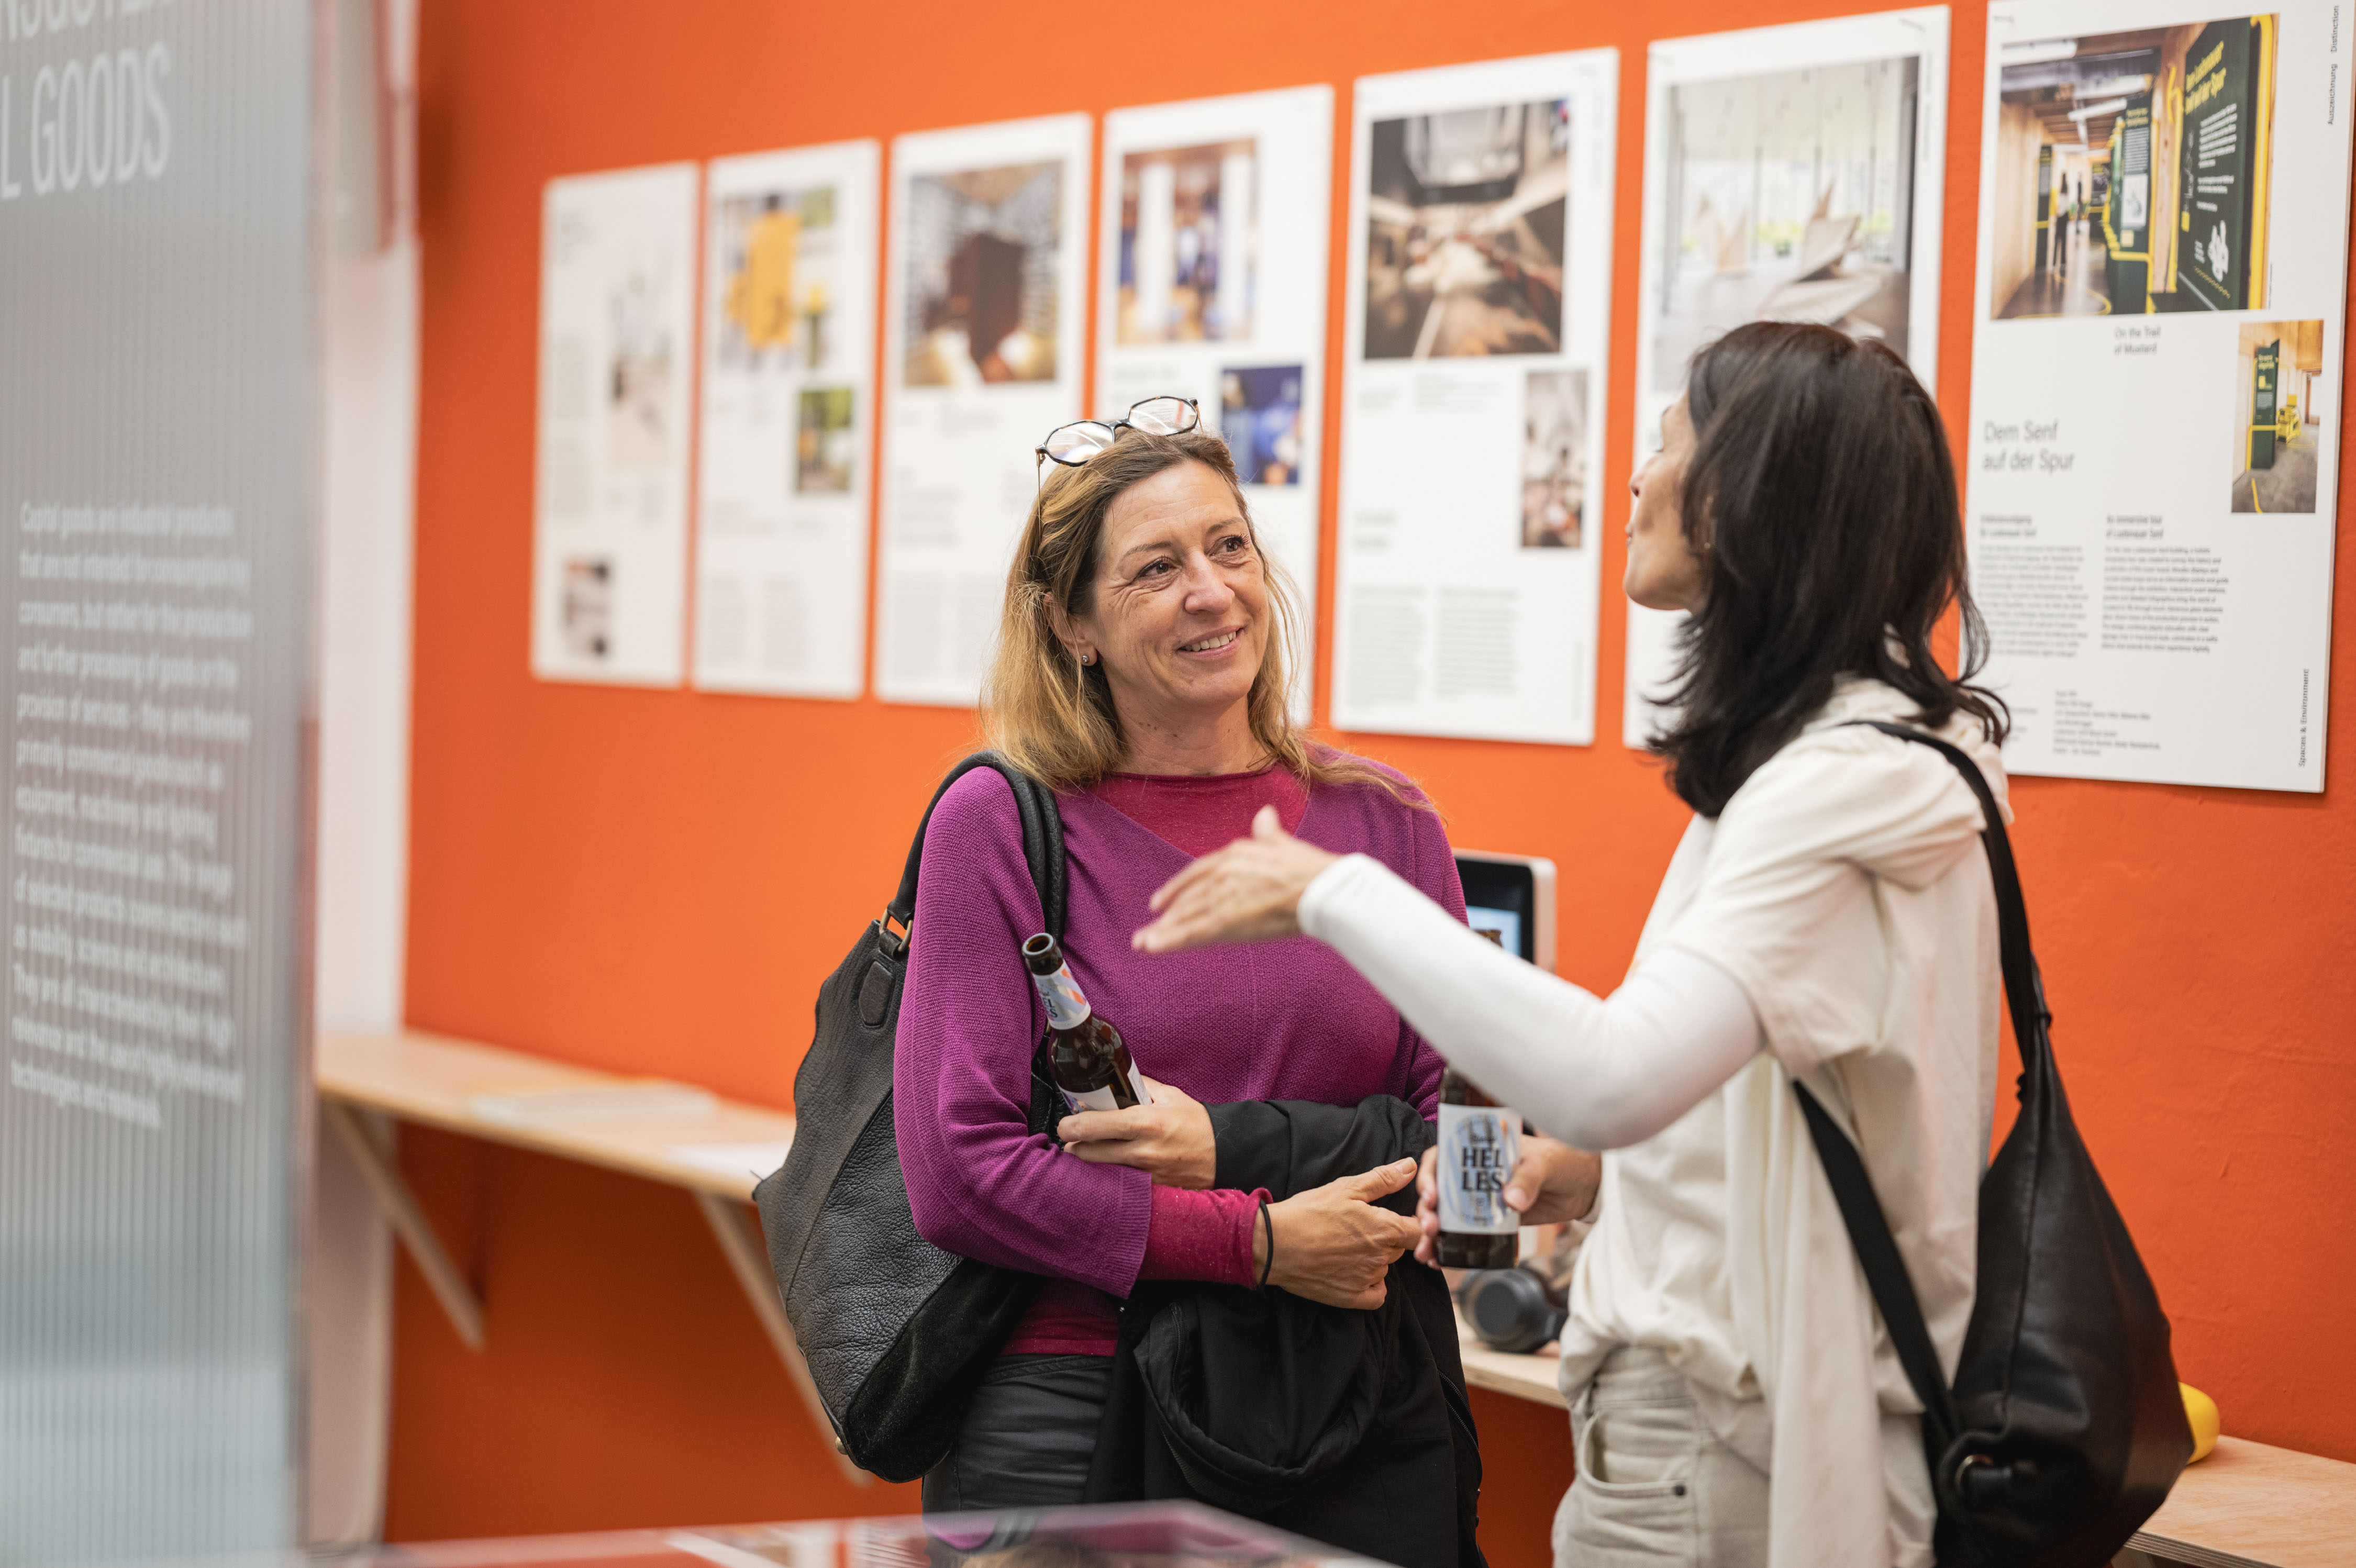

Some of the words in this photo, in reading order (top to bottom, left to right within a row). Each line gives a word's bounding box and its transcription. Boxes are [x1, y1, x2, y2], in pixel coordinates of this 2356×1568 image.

[2331, 5, 2339, 53] Distinction
[2327, 63, 2338, 126] Auszeichnung
[31, 43, 171, 196] GOODS
[2115, 327, 2127, 338] On
[2130, 326, 2141, 337] the
[2144, 325, 2161, 337] Trail
[2114, 343, 2122, 354] of
[2125, 343, 2157, 354] Mustard
[1984, 420, 2018, 442] Dem
[2024, 418, 2059, 442] Senf
[1983, 448, 2007, 470] auf
[2009, 448, 2035, 470] der
[2039, 448, 2075, 475] Spur
[2300, 668, 2309, 725] Environment
[1462, 1147, 1503, 1168] HEL
[1462, 1171, 1503, 1191] LES
